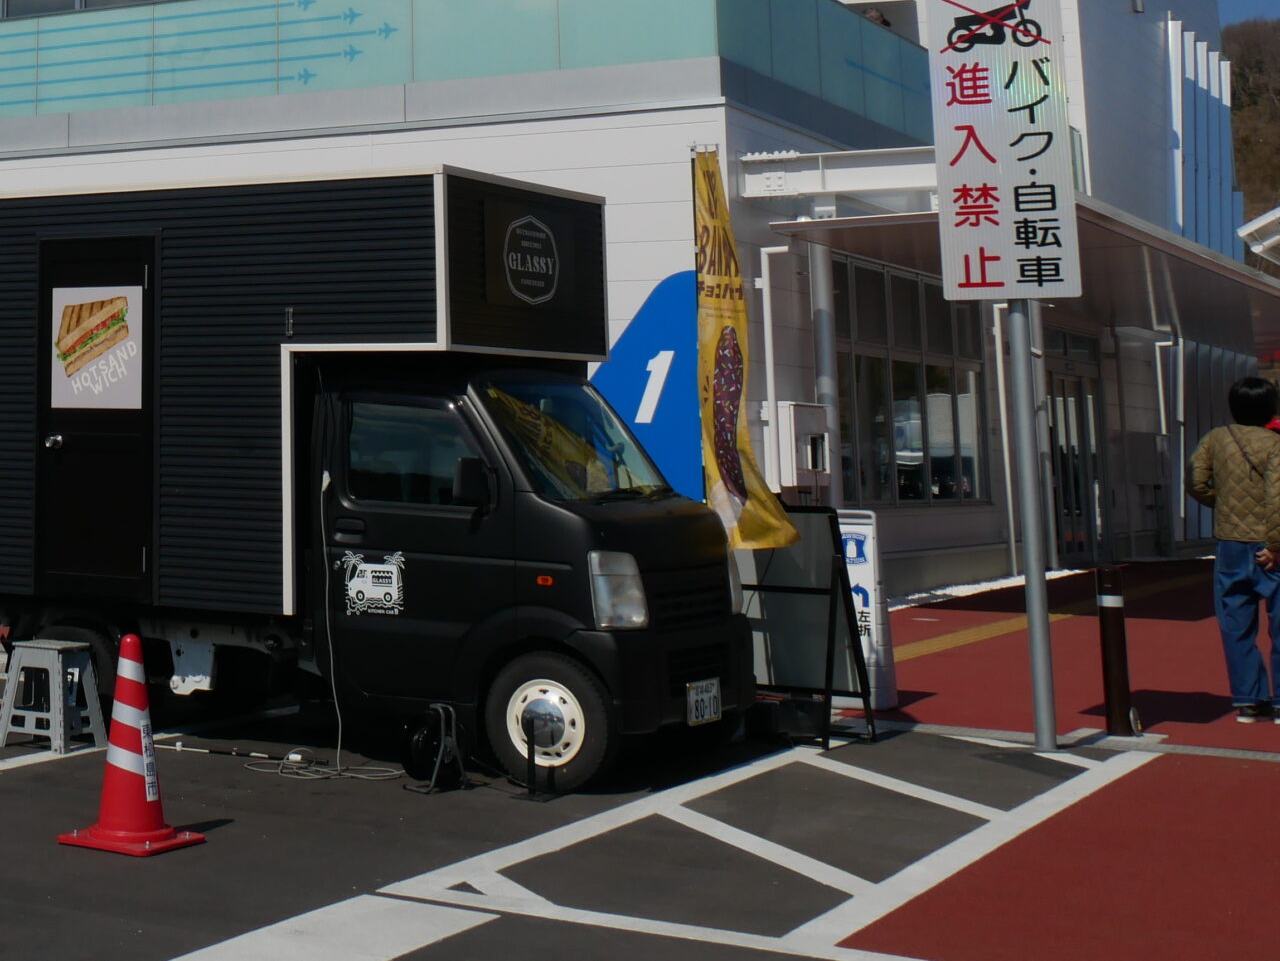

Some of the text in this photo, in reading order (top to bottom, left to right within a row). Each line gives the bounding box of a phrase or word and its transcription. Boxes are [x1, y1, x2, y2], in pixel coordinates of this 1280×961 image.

[945, 62, 1005, 288] 進入禁止
[1004, 57, 1064, 287] バイク・自転車
[508, 251, 554, 275] GLASSY
[634, 350, 675, 424] 1
[857, 610, 871, 638] 左折
